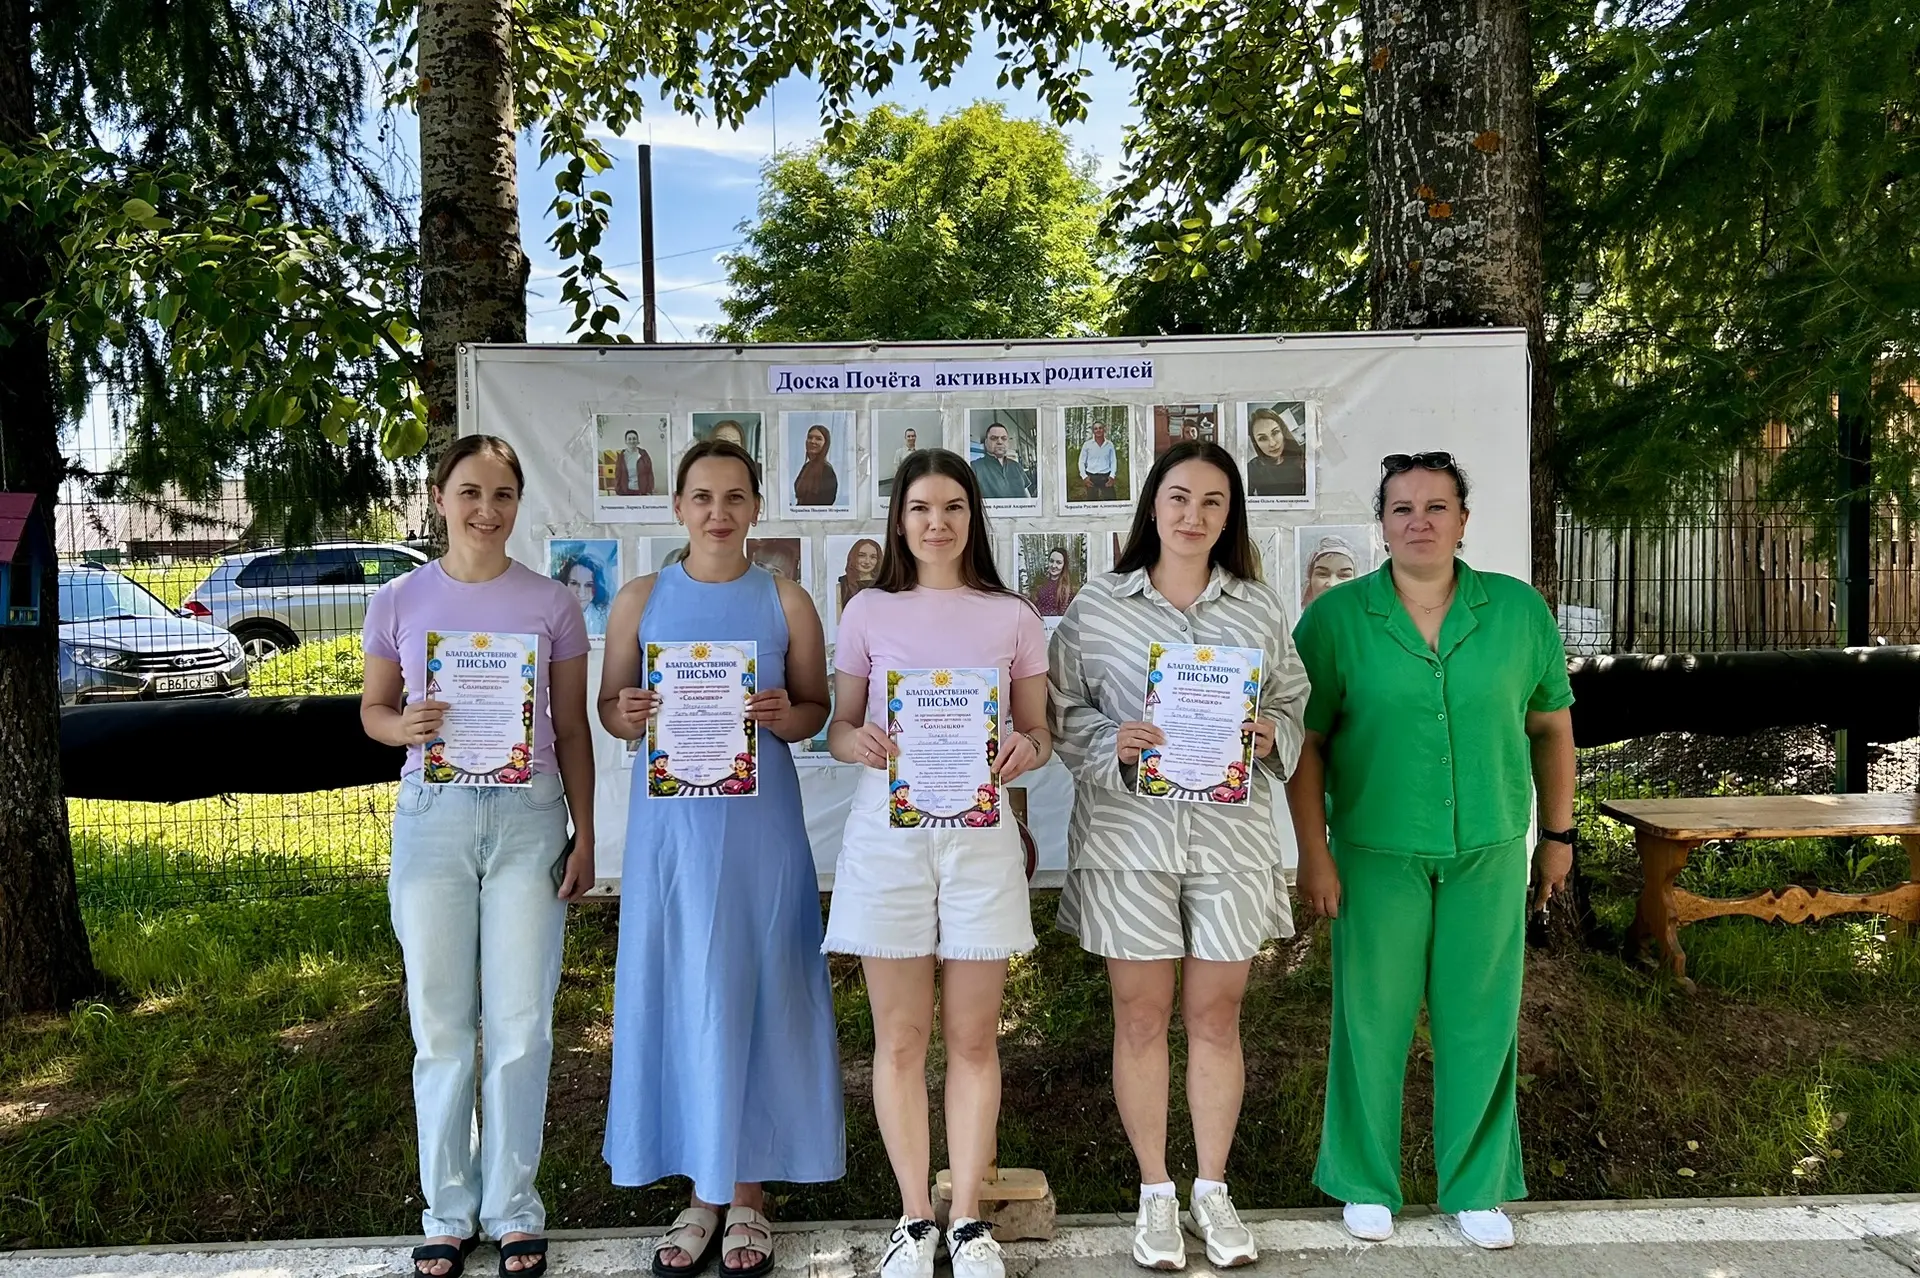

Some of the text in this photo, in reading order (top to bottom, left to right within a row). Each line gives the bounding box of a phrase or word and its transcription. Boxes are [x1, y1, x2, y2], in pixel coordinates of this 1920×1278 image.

[776, 361, 1153, 393] Доска Почёта активных родителей
[445, 651, 518, 659] БЛАГОДАРСТВЕННОЕ
[456, 659, 507, 669] ПИСЬМО
[665, 661, 738, 669] БЛАГОДАРСТВЕННОЕ
[1167, 662, 1241, 674] БЛАГОДАРСТВЕННОЕ
[677, 669, 727, 679] ПИСЬМО
[1177, 671, 1229, 684] ПИСЬМО
[905, 688, 979, 696] БЛАГОДАРСТВЕННОЕ
[917, 697, 968, 707] ПИСЬМО
